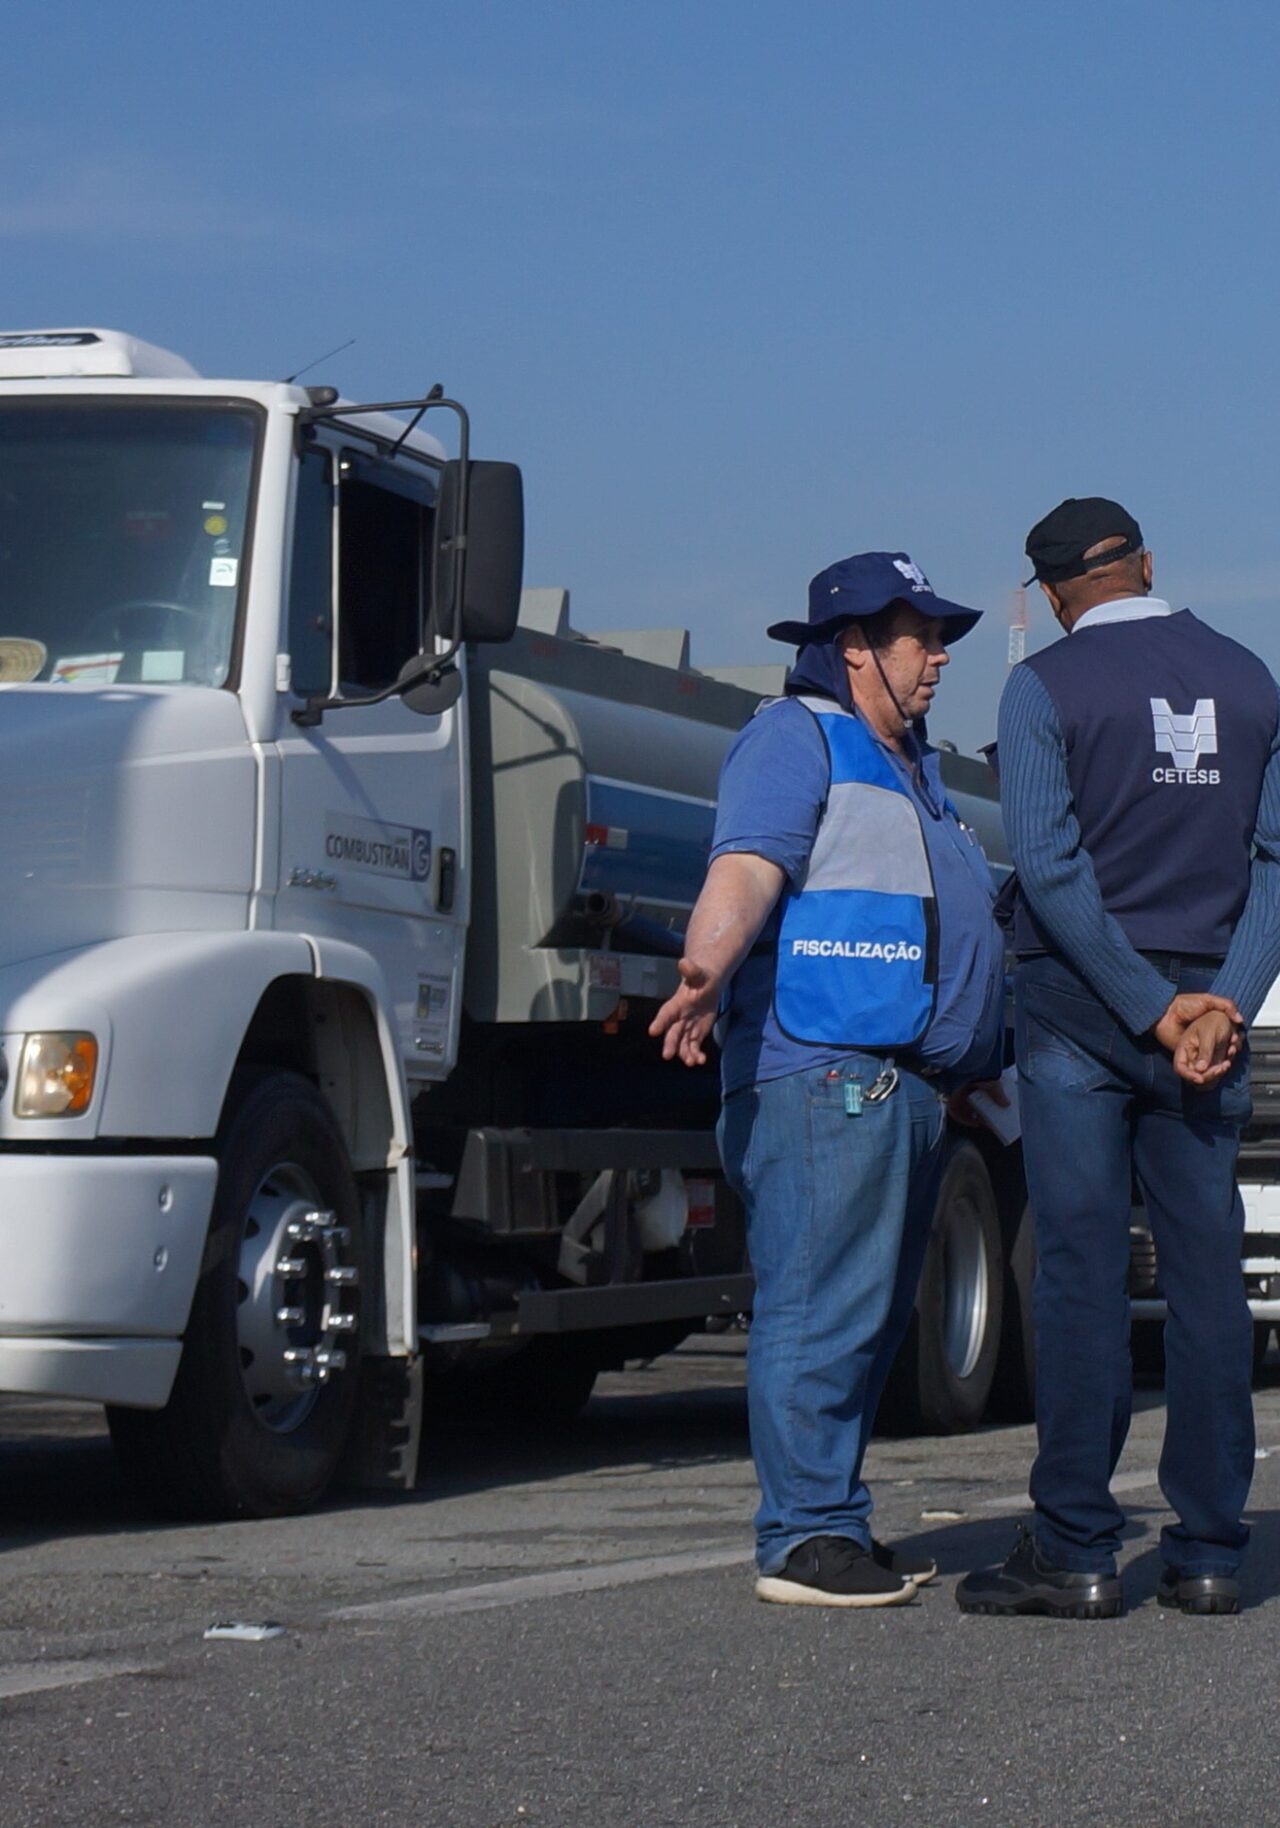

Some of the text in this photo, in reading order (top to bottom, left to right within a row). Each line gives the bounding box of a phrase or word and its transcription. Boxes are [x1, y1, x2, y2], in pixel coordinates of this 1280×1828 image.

[1152, 767, 1221, 785] CETESB
[326, 834, 411, 871] COMBUSTRAN
[792, 939, 922, 963] FISCALIZAÇÃO
